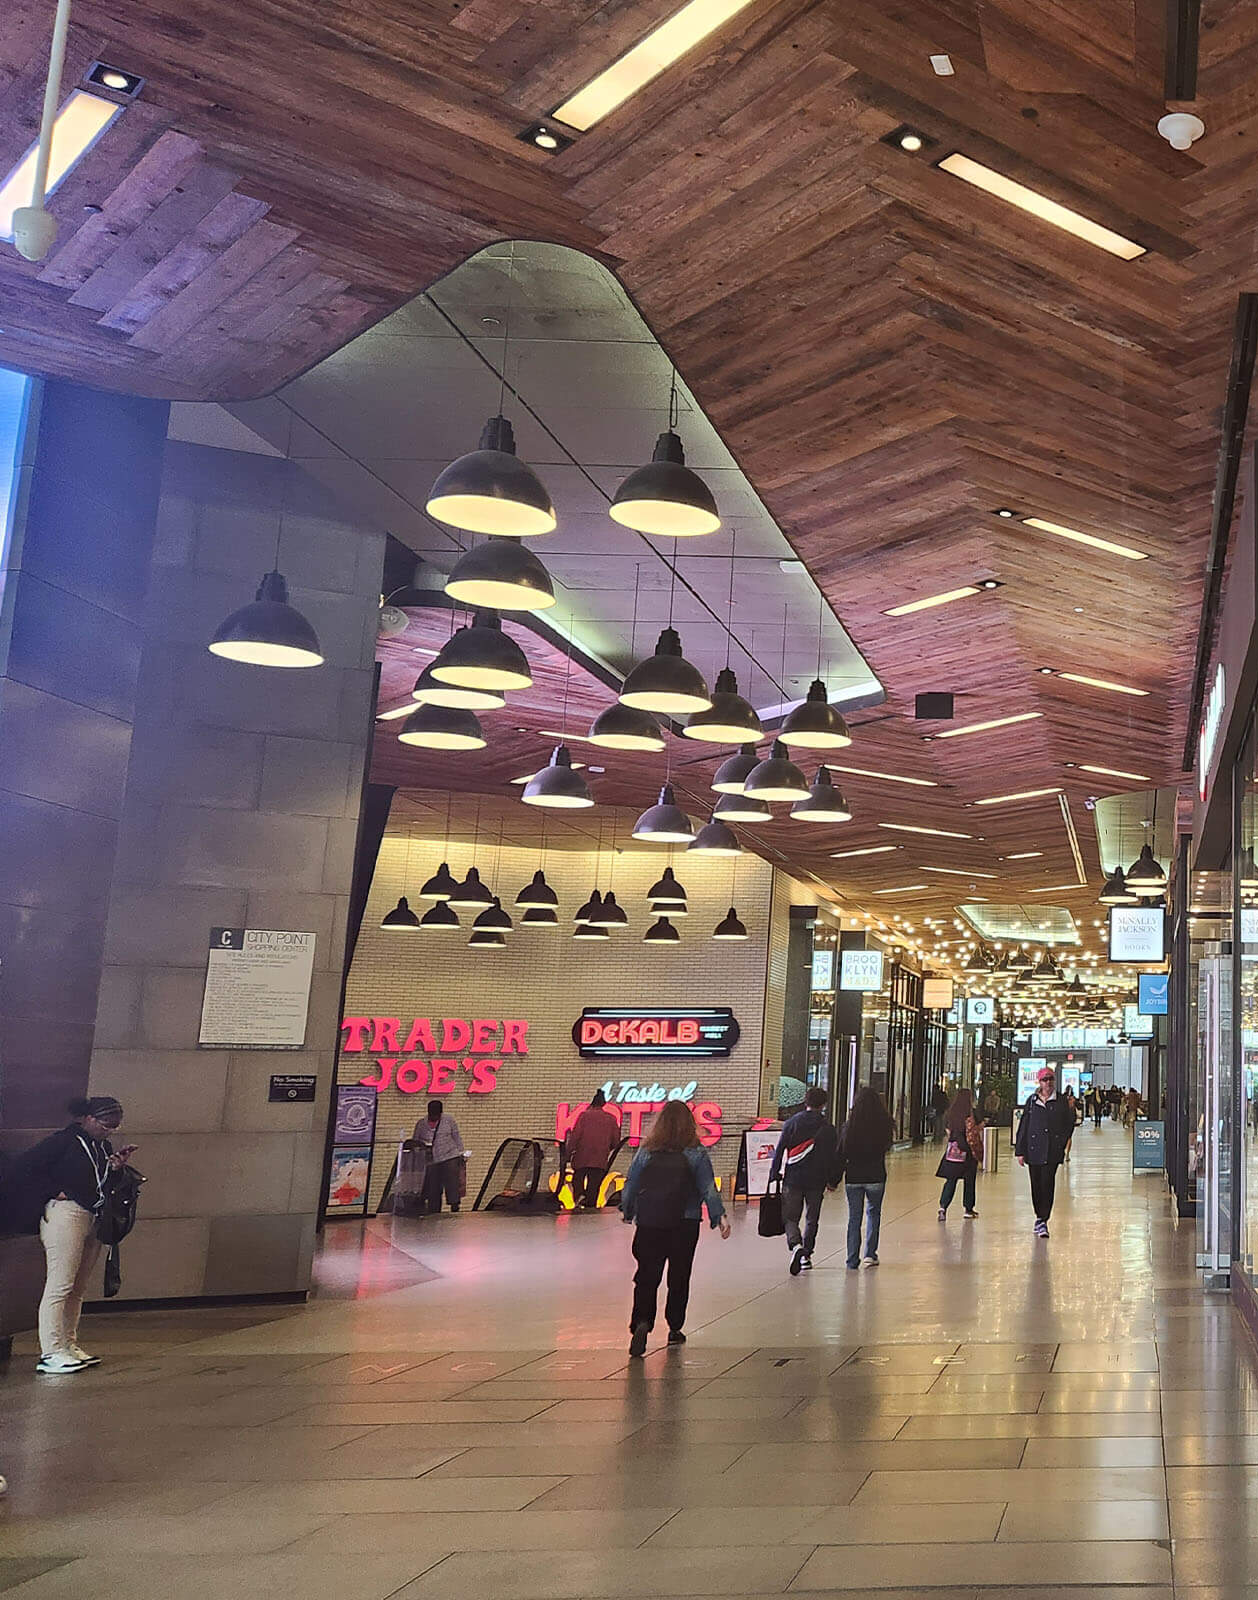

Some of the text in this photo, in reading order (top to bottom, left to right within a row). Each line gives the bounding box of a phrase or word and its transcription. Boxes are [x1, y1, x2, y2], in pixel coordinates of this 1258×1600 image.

[1117, 925, 1157, 933] JACKSON
[221, 930, 232, 945] C
[247, 931, 311, 945] CITY POINT
[846, 954, 878, 964] BROO
[341, 1017, 529, 1054] TRADER
[581, 1020, 700, 1045] DeKALB
[360, 1057, 503, 1094] JOE'S
[615, 1081, 667, 1103] Taste
[667, 1080, 698, 1102] of
[1138, 1130, 1160, 1139] 30%
